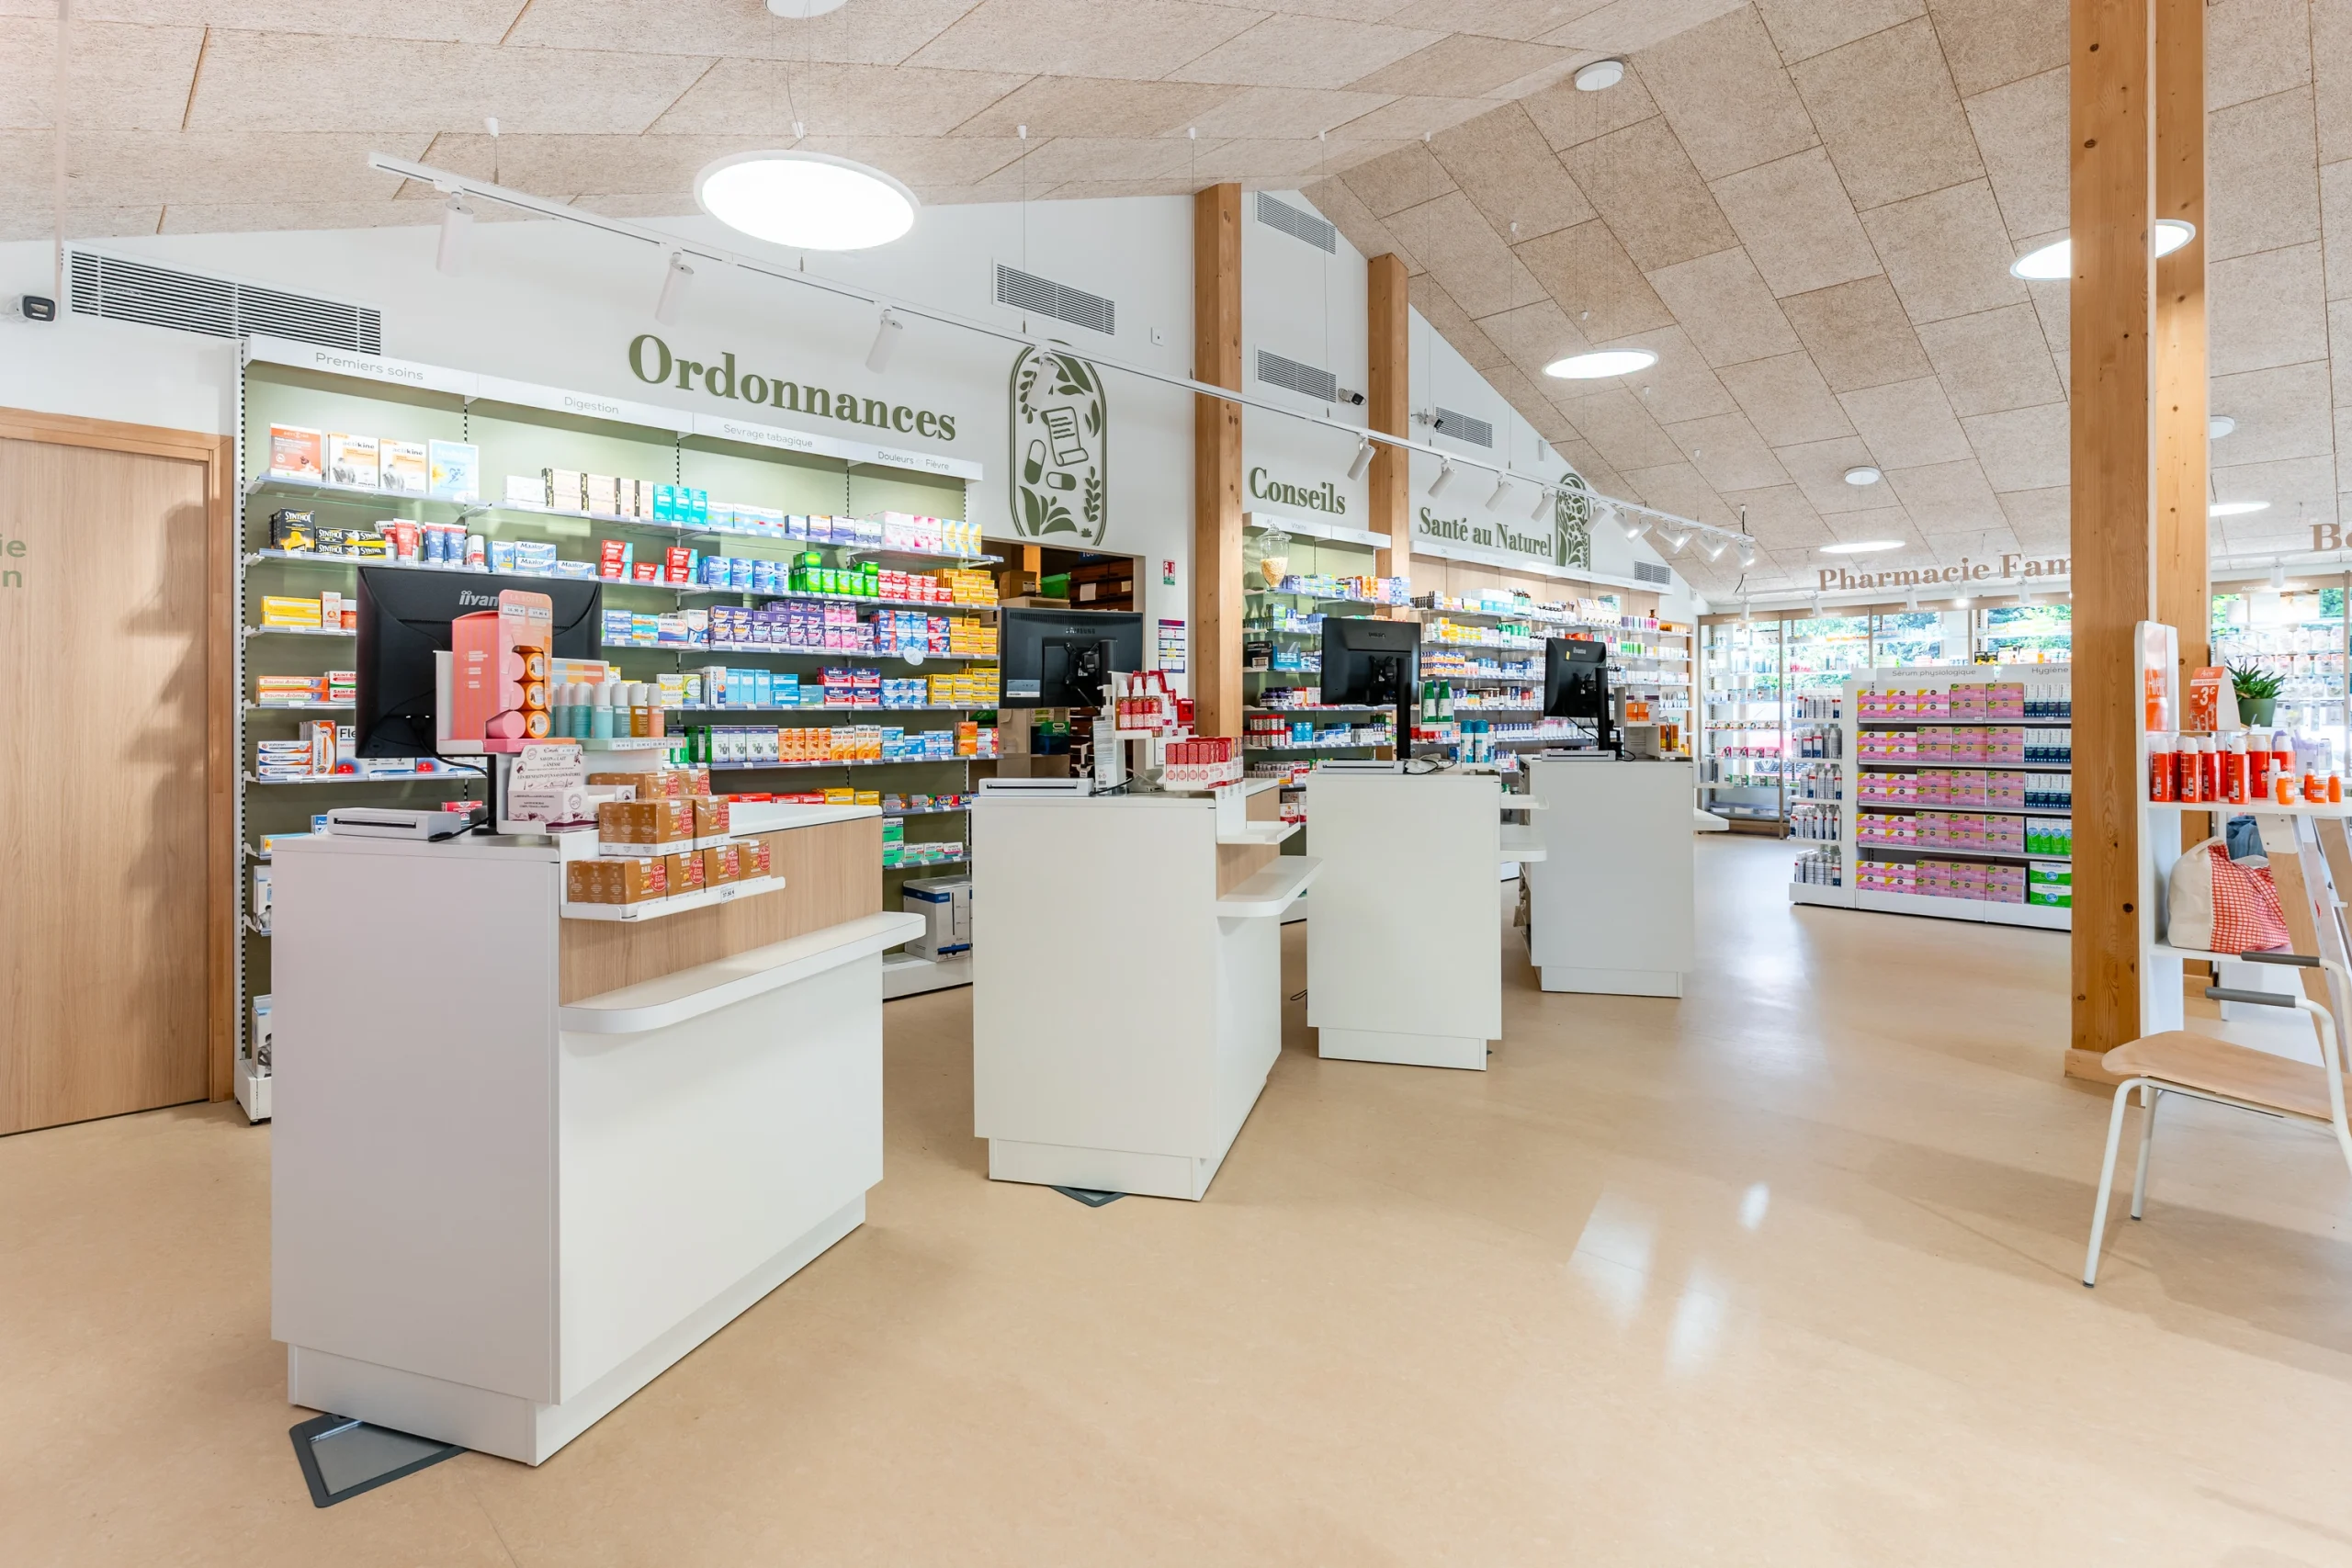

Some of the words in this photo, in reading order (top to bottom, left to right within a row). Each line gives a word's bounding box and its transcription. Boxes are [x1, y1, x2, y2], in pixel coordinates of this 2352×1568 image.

[315, 352, 383, 374] Premiers
[388, 367, 424, 380] soins
[628, 333, 956, 441] Ordonnances
[564, 396, 619, 415] Digestion
[724, 423, 764, 441] Sevrage
[766, 430, 813, 448] tabagique
[342, 441, 375, 449] actikine
[391, 446, 424, 456] actikine
[877, 451, 914, 465] Douleurs
[925, 457, 950, 471] Fièvre
[1250, 467, 1346, 514] Conseils
[285, 511, 311, 523] SYNTHOL
[318, 529, 344, 540] SYNTHOL
[1419, 507, 1469, 542] Santé
[1474, 527, 1492, 547] au
[1496, 523, 1553, 557] Naturel
[318, 544, 344, 554] SYNTHOL
[520, 542, 545, 550] Maalox
[520, 558, 545, 566] Maalox
[560, 561, 585, 570] Maalox
[1817, 558, 1991, 592] Pharmacie
[1892, 669, 1918, 677] Sérum
[1919, 669, 1976, 678] physiologique
[2031, 666, 2069, 676] Hygiène
